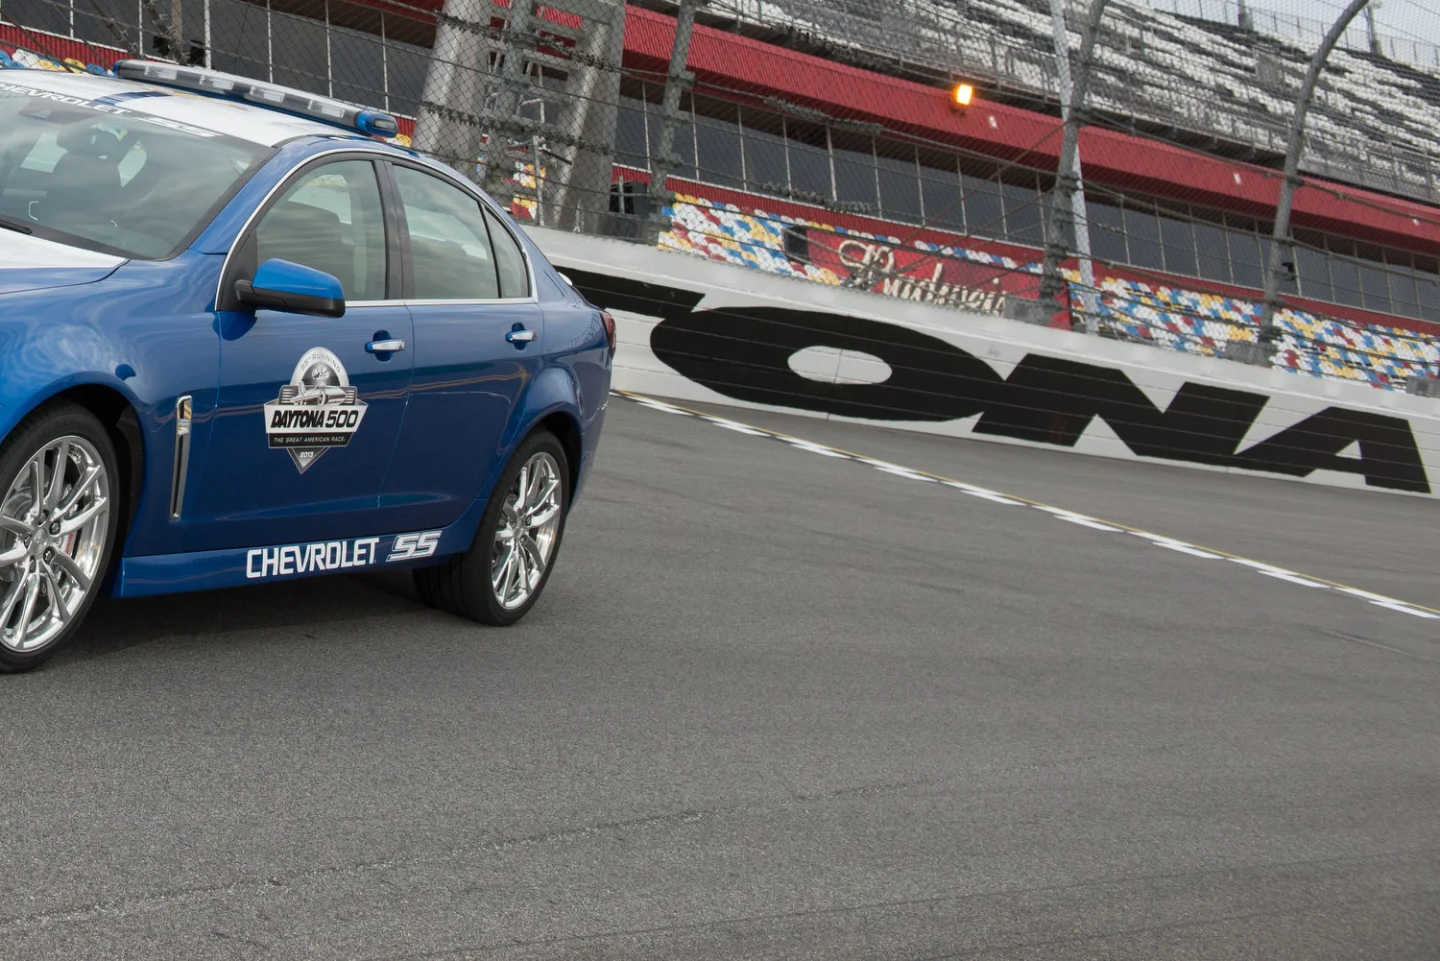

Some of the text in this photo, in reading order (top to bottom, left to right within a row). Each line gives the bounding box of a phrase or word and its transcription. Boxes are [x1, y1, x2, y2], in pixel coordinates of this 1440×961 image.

[270, 410, 359, 428] DAYTONA 500
[246, 530, 443, 579] CHEVROLET SS
